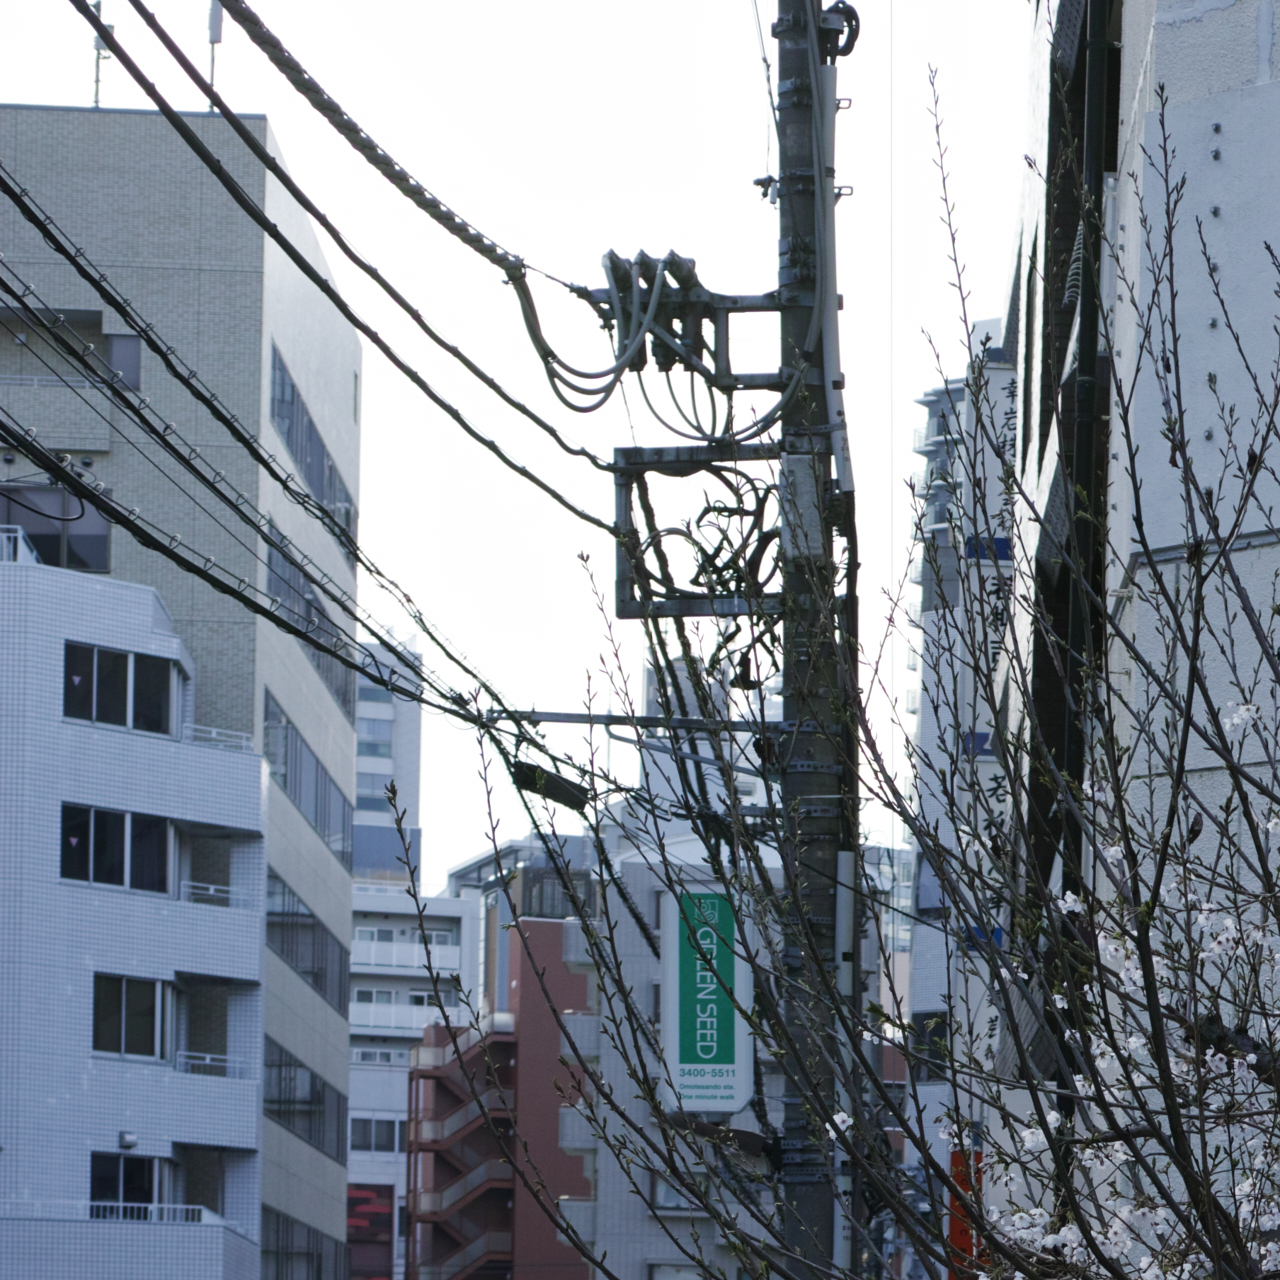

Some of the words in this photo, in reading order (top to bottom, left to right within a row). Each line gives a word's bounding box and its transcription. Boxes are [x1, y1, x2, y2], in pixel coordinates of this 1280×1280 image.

[697, 1004, 717, 1059] SEED
[679, 1068, 735, 1078] 3400-5511
[679, 1083, 721, 1091] Omotesando
[722, 1083, 735, 1091] sta.
[694, 1093, 718, 1101] minute
[719, 1093, 735, 1101] walk
